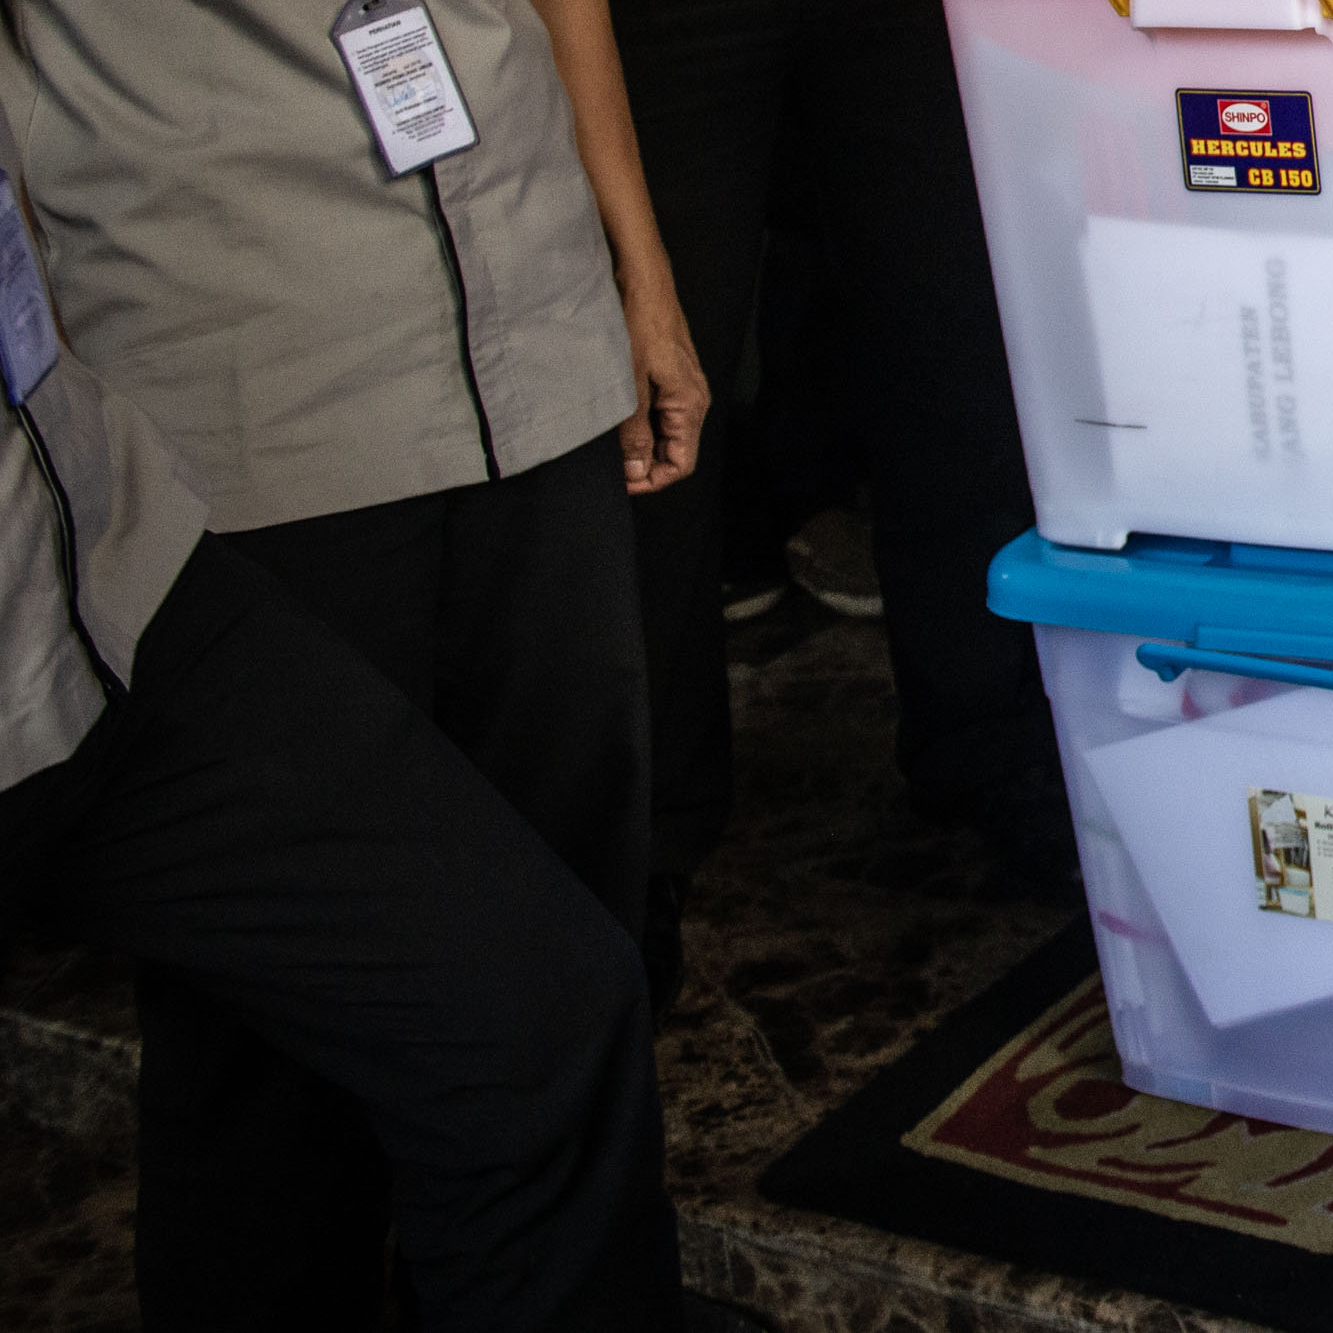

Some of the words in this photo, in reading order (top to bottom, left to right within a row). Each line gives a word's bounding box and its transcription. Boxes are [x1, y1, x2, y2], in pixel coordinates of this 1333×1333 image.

[1224, 112, 1266, 124] SHINPO
[1190, 138, 1307, 159] HERCULES
[1248, 168, 1275, 187] CB
[1280, 169, 1313, 188] 150
